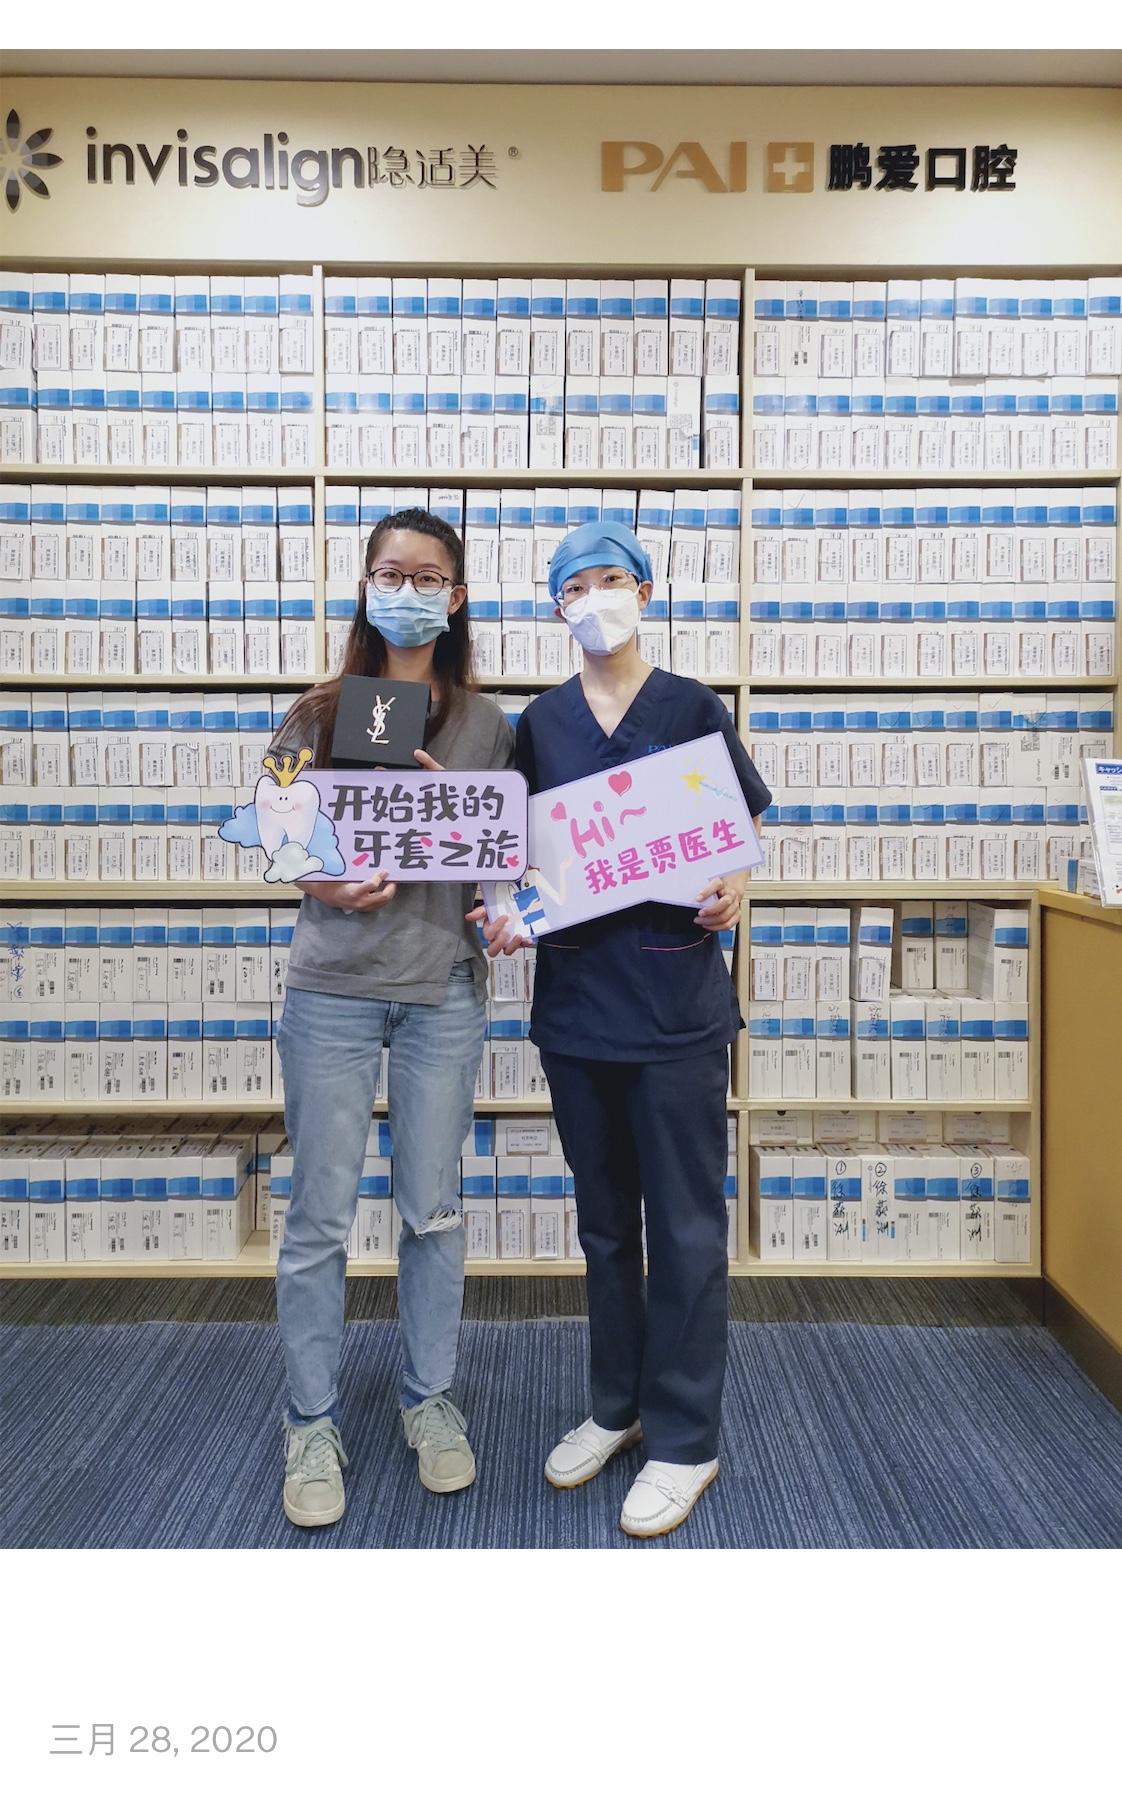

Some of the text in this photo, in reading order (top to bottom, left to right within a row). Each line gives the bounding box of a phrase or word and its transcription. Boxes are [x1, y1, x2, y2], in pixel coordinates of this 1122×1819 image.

[86, 126, 366, 207] invisalign
[367, 143, 498, 190] 隐适美
[601, 141, 1019, 193] PAI 鹏爱口腔
[366, 694, 397, 745] YSL
[328, 784, 504, 823] 开始我的
[352, 829, 521, 870] 牙套之旅
[583, 818, 746, 896] 我是贾医生
